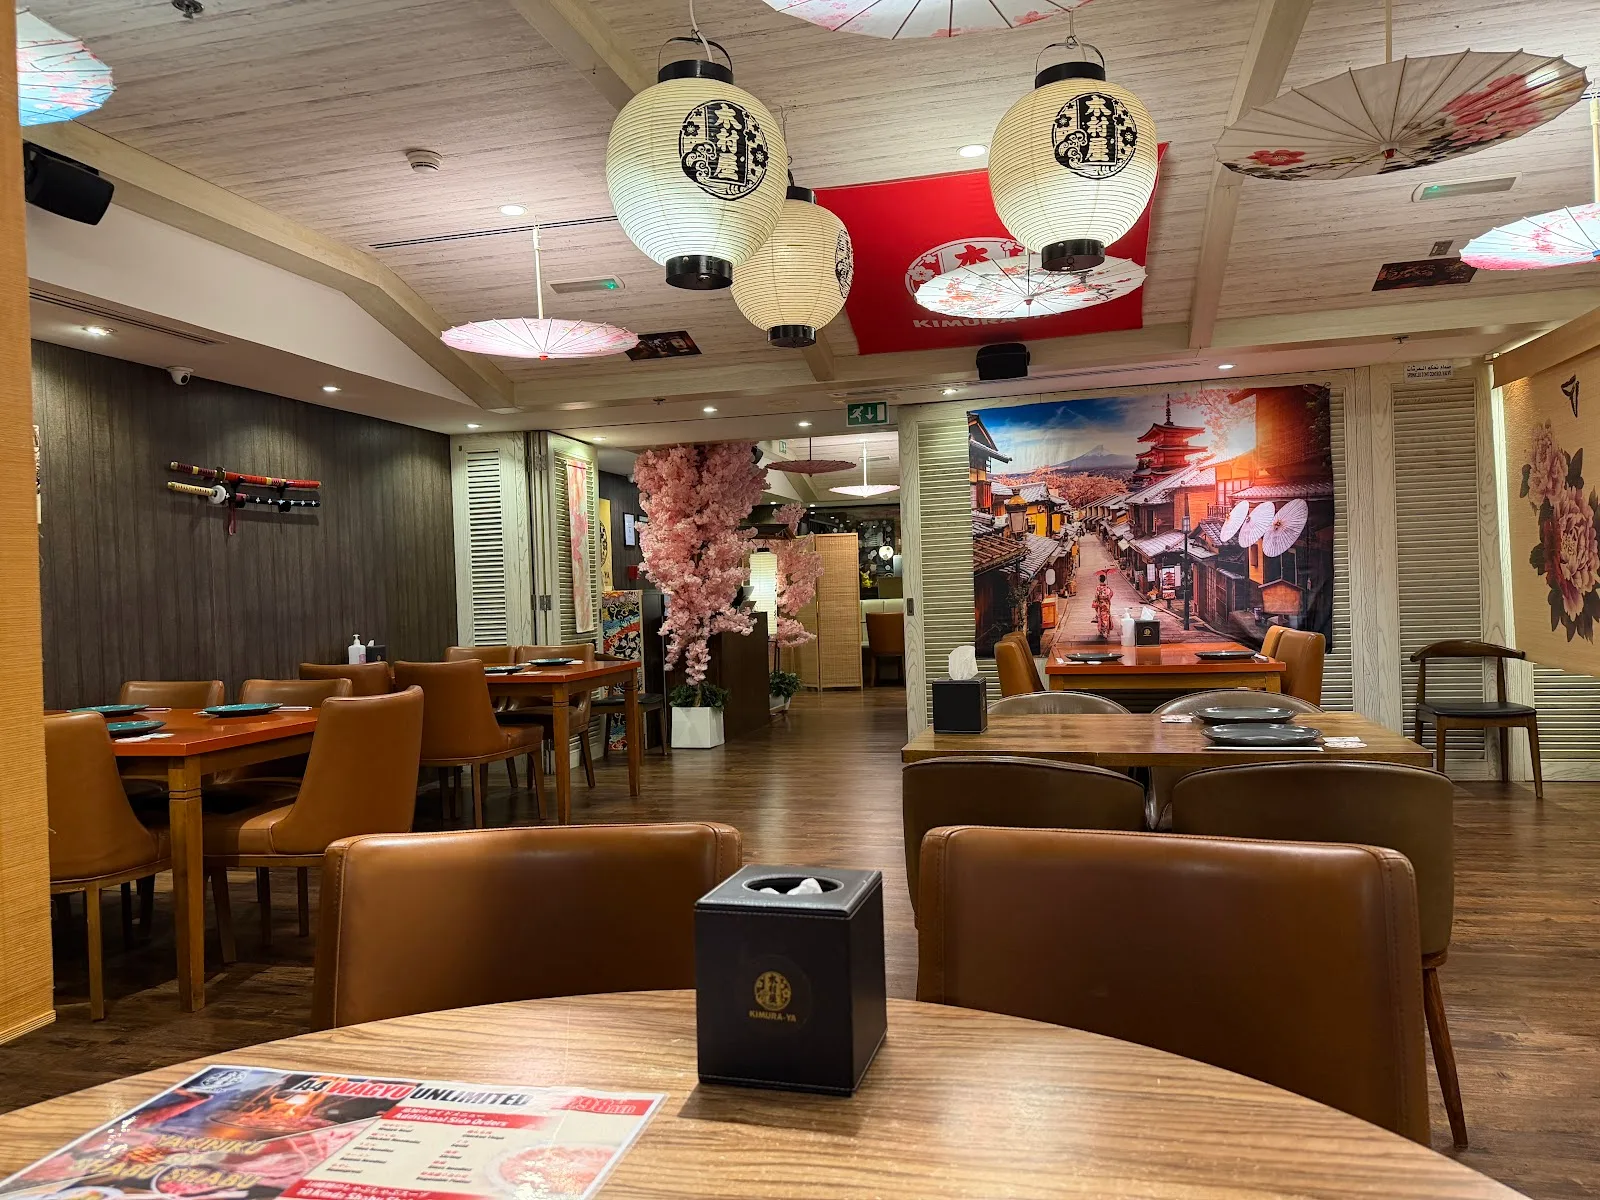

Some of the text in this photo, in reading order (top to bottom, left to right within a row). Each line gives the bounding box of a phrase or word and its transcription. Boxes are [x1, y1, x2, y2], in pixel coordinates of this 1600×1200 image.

[298, 1079, 531, 1106] A4 WAGYU UNLIMITED
[391, 1112, 509, 1127] Additional Side Orders
[158, 1134, 266, 1155] YAKINIKU
[71, 1157, 261, 1189] SHABU SHABU
